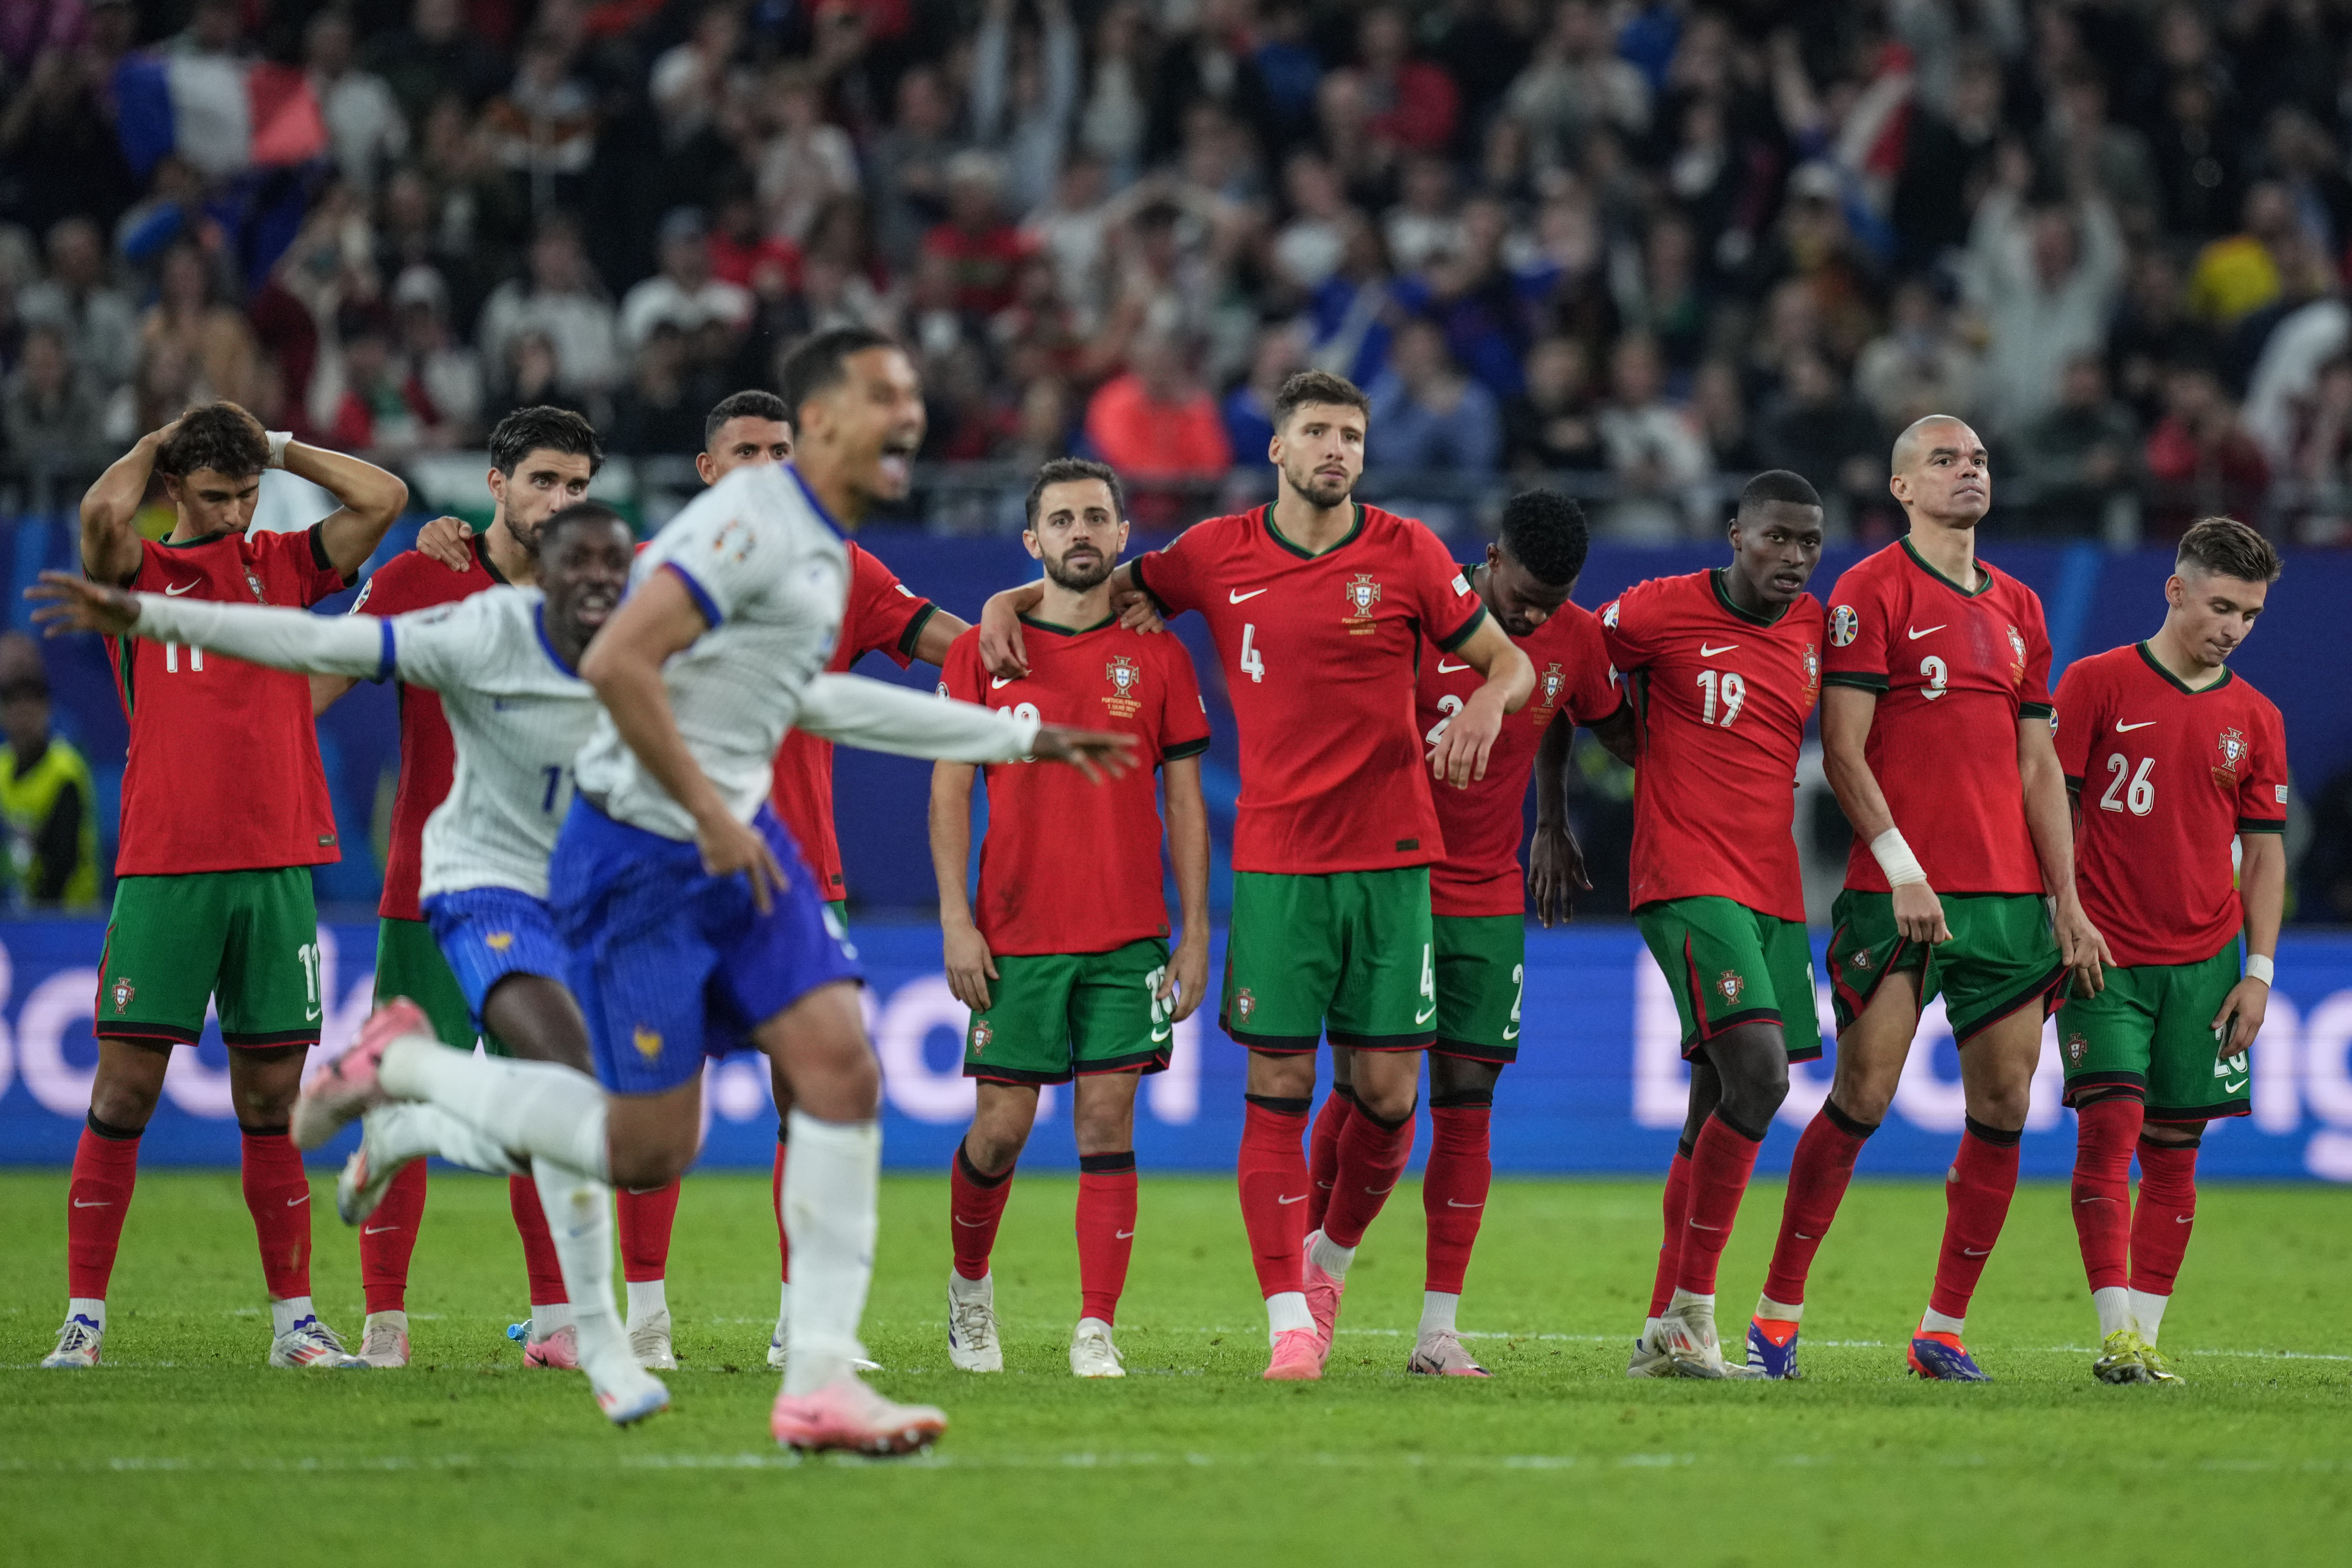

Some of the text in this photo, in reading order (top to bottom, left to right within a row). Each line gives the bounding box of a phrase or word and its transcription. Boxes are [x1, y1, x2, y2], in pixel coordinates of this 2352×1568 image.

[1240, 623, 1265, 683] 4
[1920, 655, 1947, 700] 3
[1696, 669, 1746, 727] 19
[2100, 753, 2155, 816] 26
[298, 943, 320, 1003] 11
[1420, 943, 1434, 1002] 4
